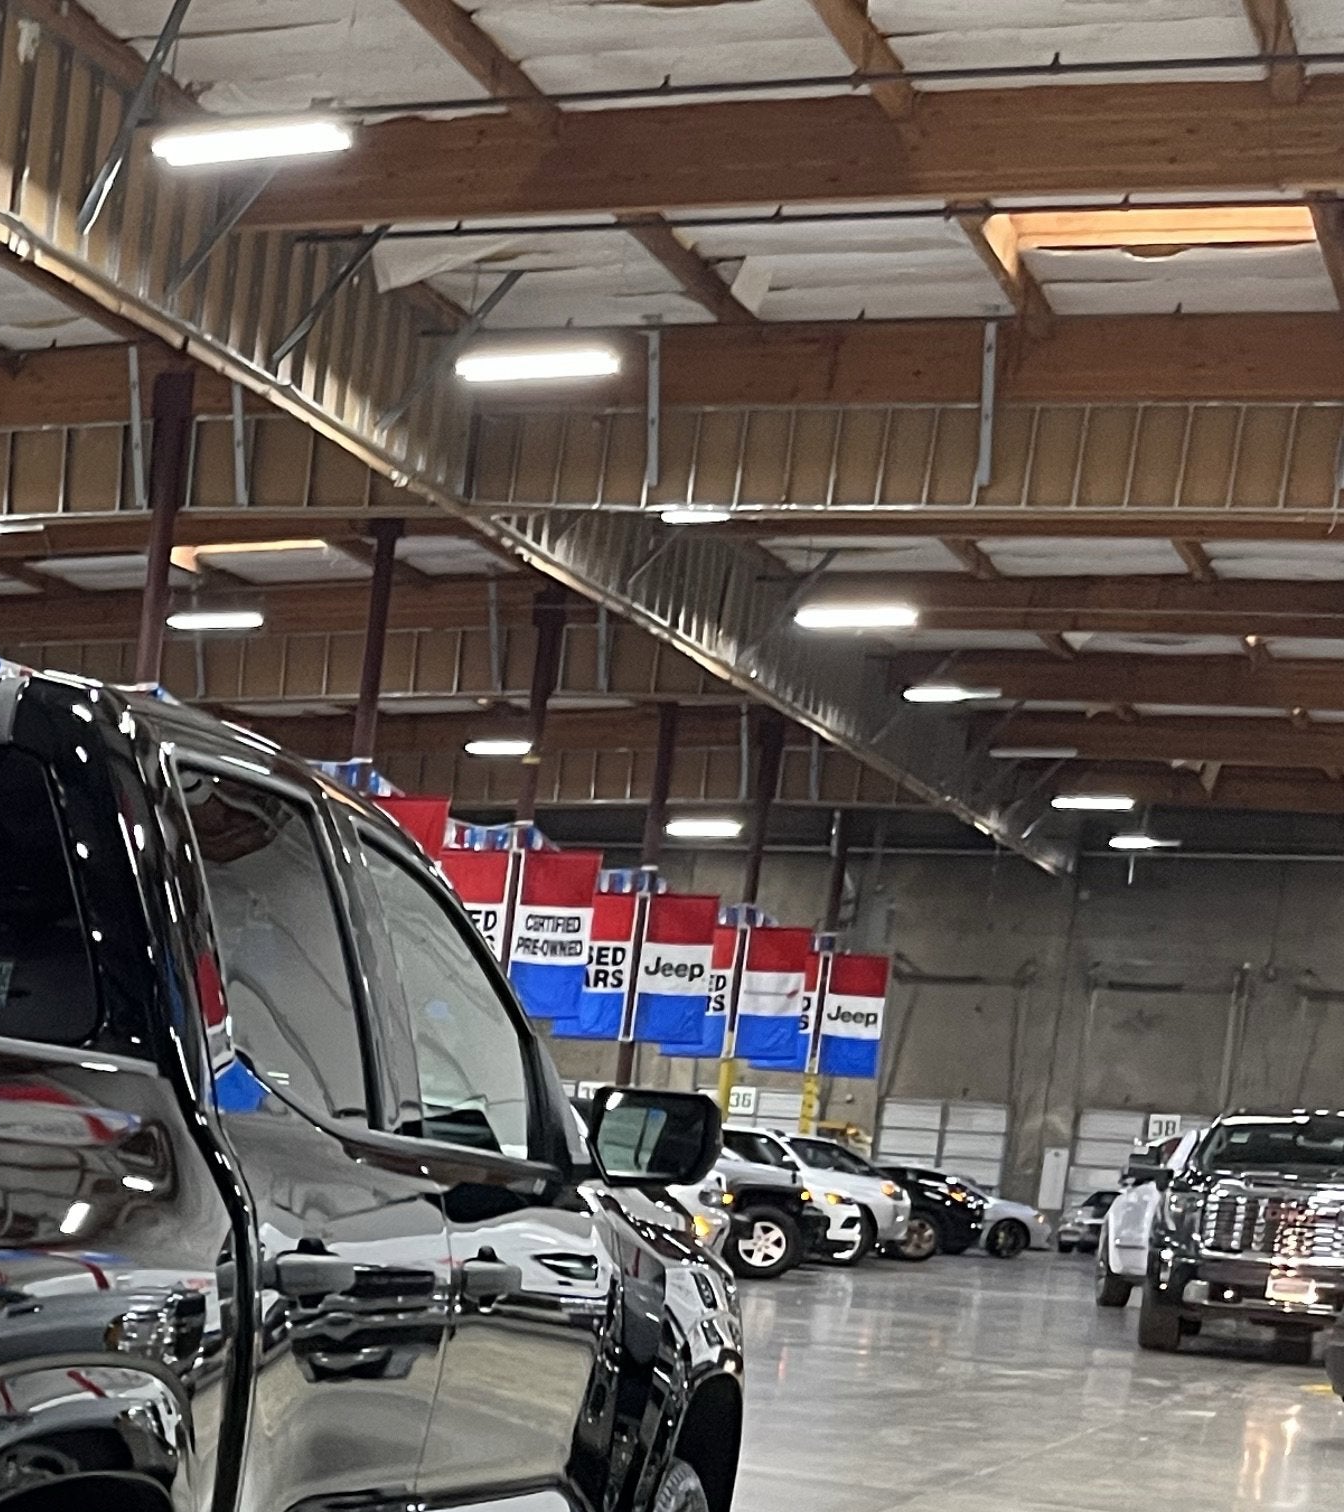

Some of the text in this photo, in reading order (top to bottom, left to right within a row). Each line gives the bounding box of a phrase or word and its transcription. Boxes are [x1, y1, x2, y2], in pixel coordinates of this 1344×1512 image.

[524, 913, 582, 934] CERTIFIED
[515, 935, 584, 958] PRE-OWNED
[644, 956, 705, 982] Jeep
[826, 1005, 878, 1027] Jeep
